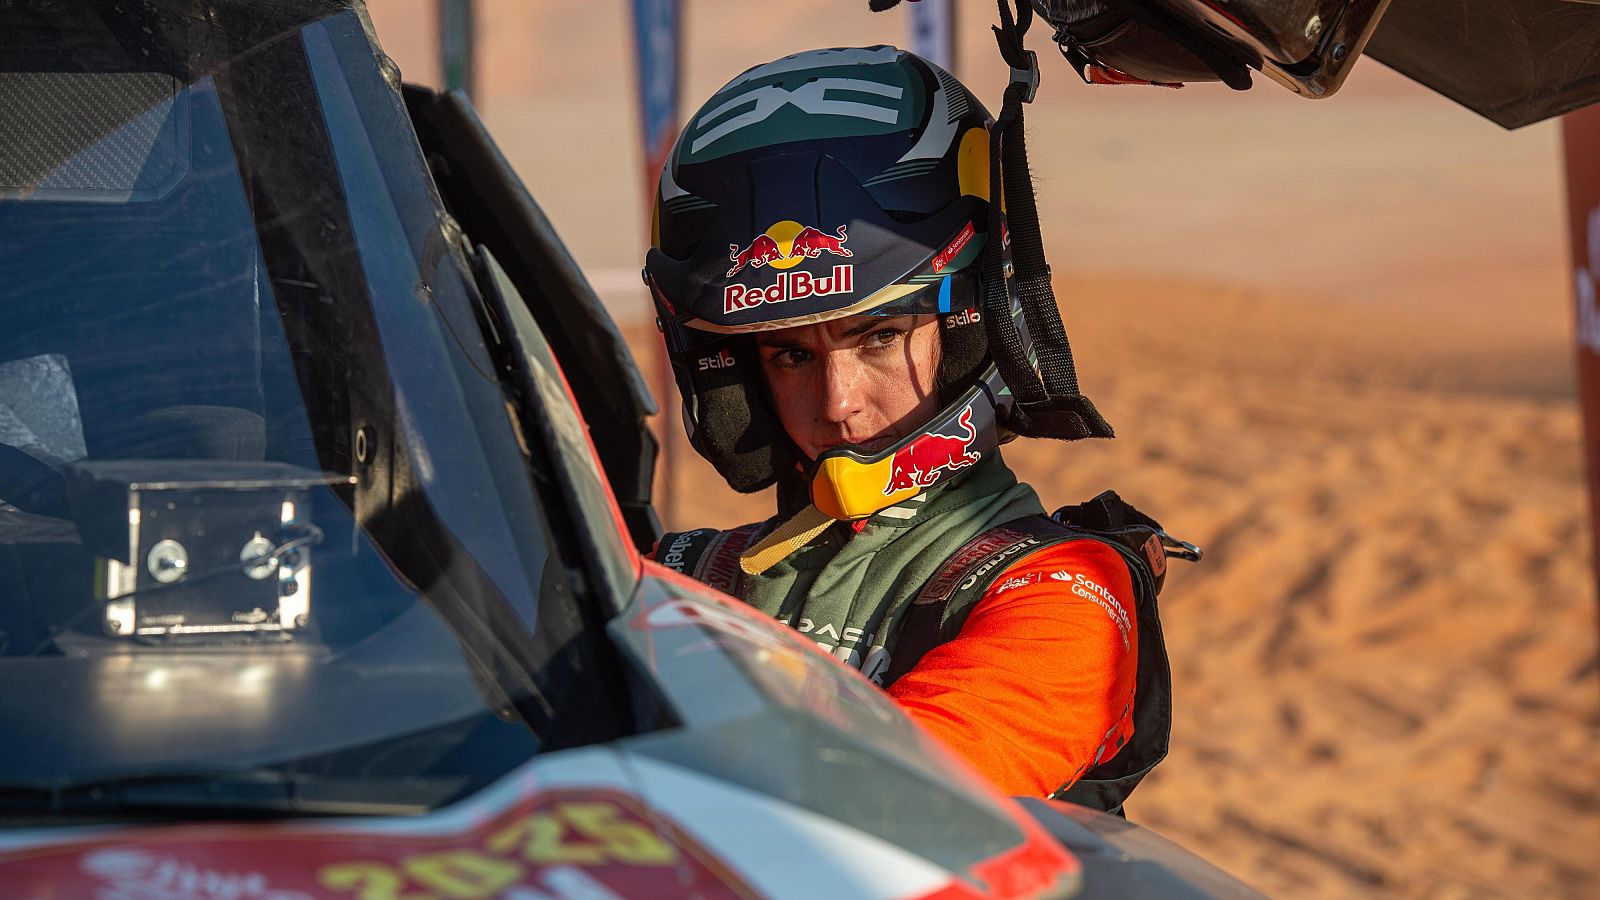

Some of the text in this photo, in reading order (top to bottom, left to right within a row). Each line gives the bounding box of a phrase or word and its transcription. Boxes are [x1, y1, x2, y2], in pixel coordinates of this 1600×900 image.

[724, 265, 853, 314] Red Bull
[664, 530, 703, 573] Sabel
[1071, 583, 1117, 620] Consumer
[1075, 573, 1132, 632] Santander
